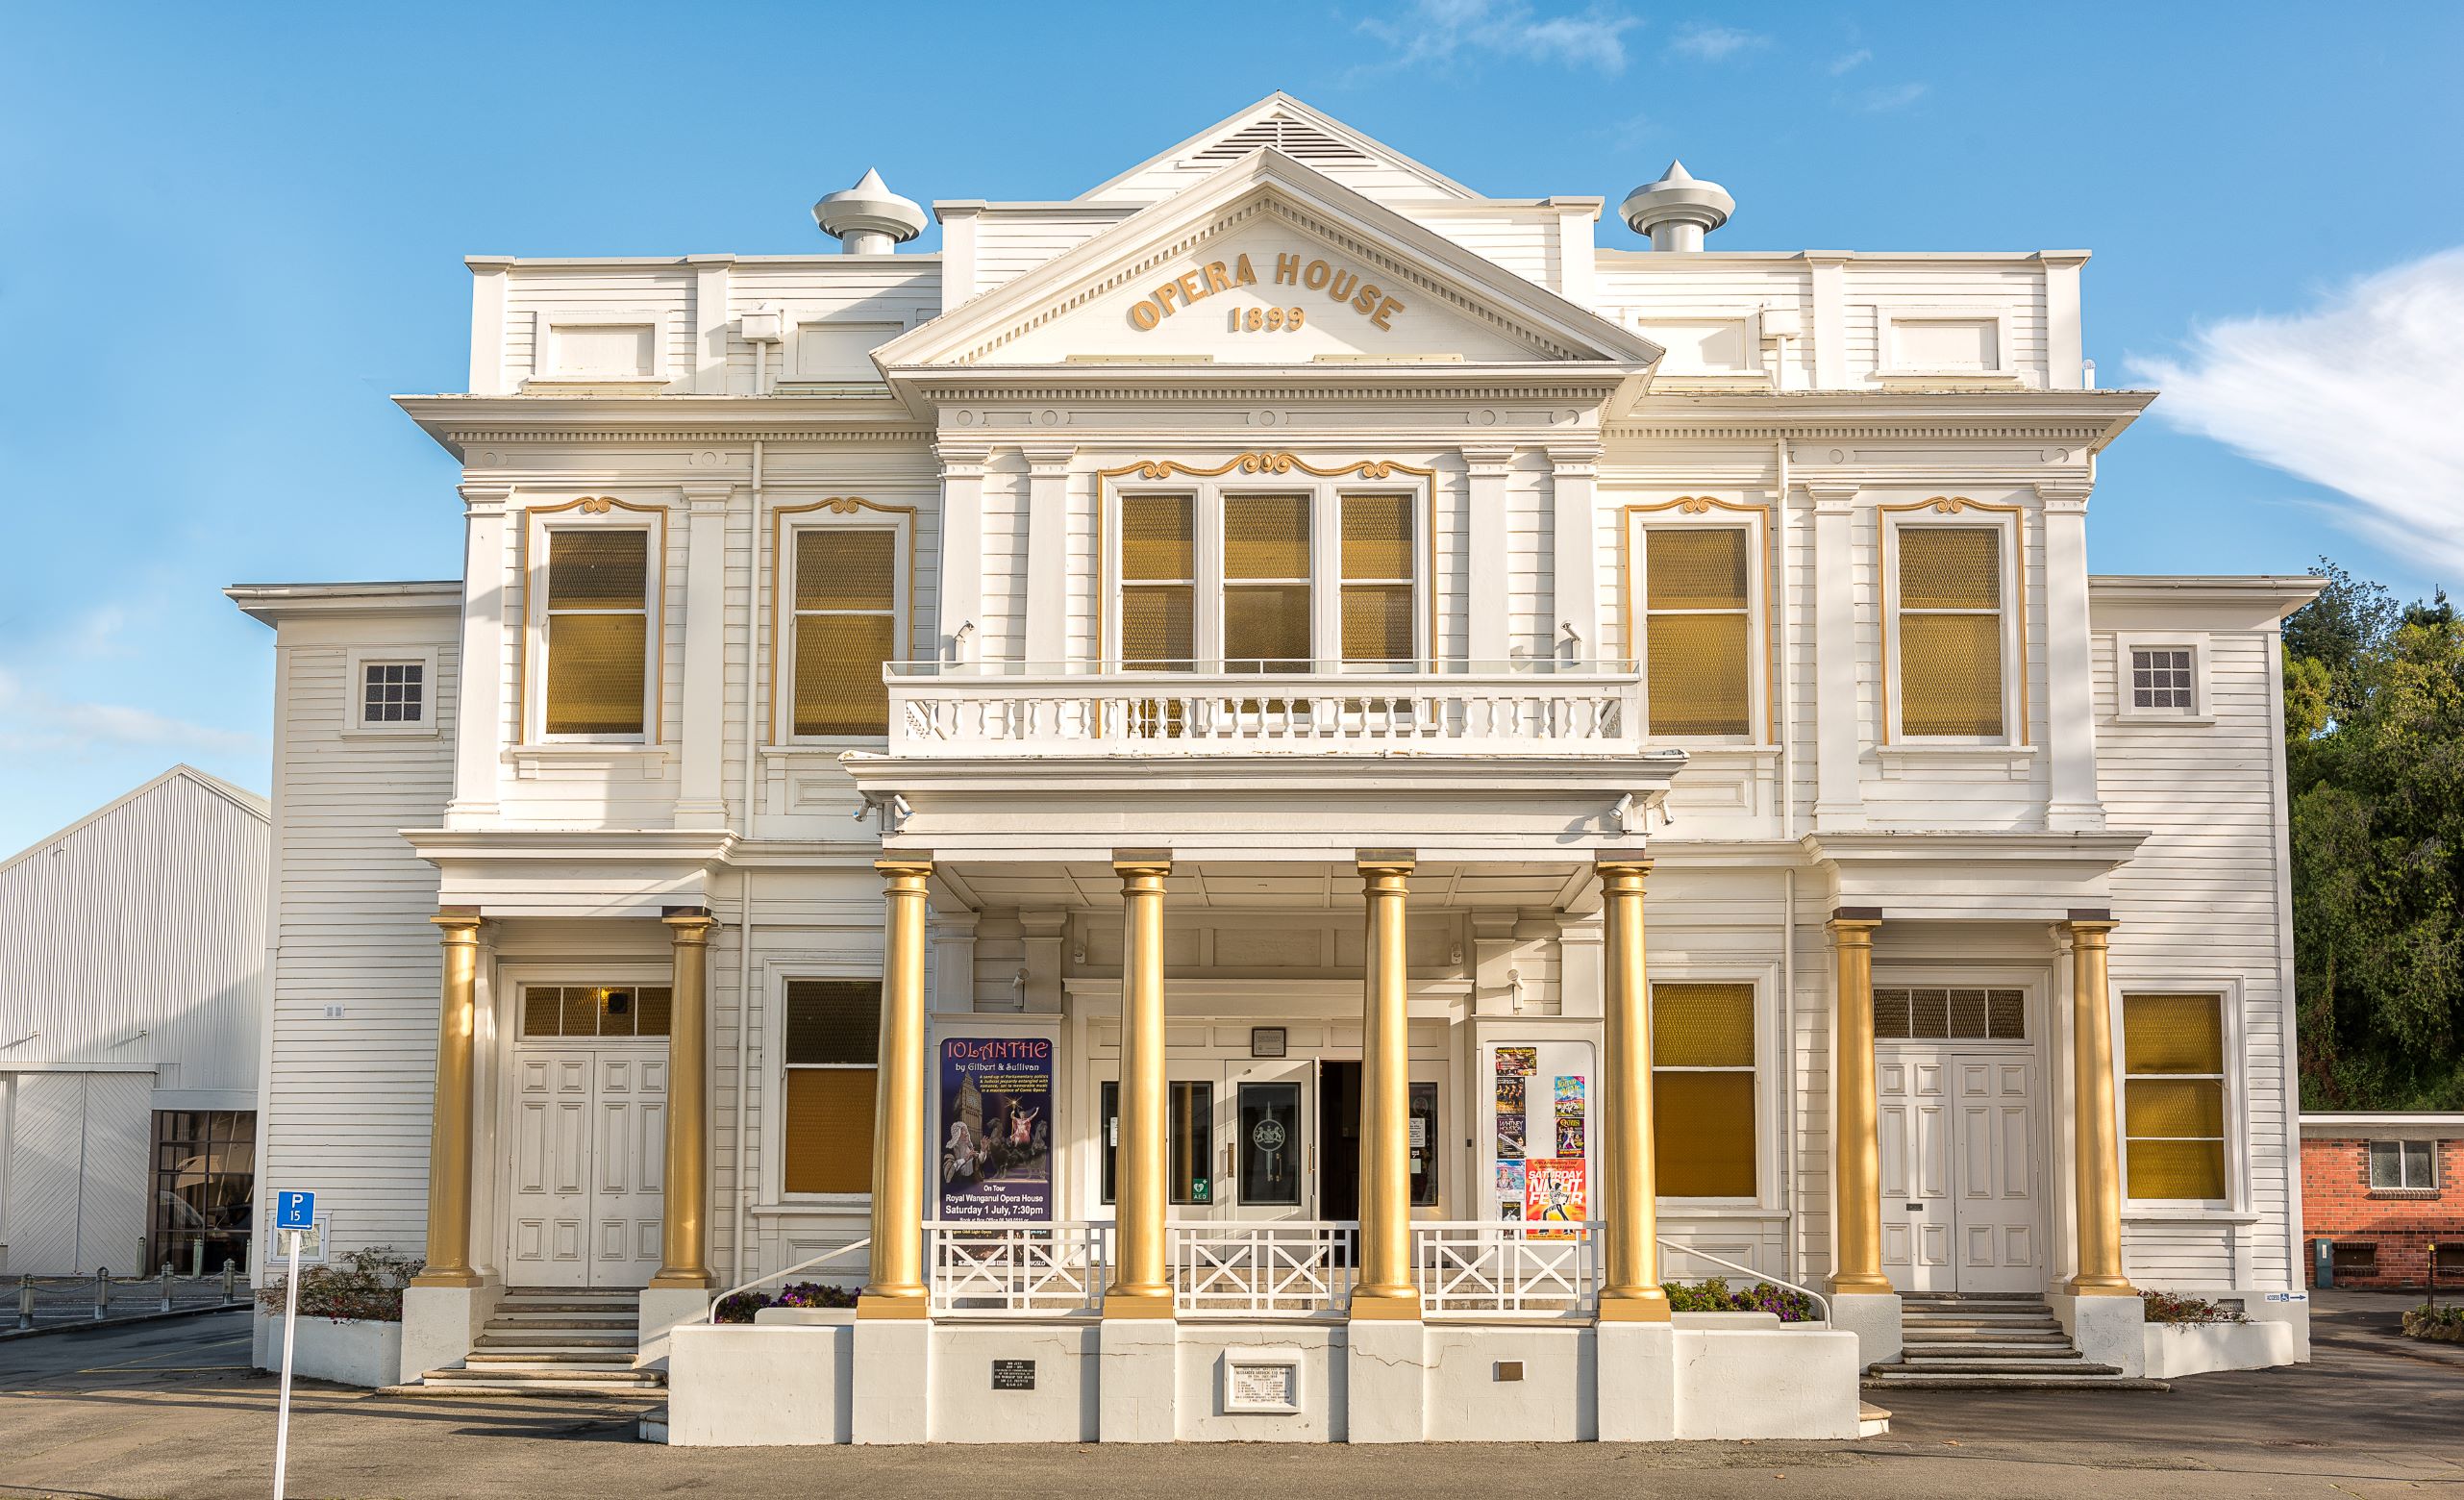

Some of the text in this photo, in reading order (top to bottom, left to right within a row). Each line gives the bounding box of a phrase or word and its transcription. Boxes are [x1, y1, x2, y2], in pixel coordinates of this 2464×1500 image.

[1132, 252, 1406, 332] OPERA HOUSE
[1232, 307, 1306, 332] 1899
[947, 1041, 1049, 1062] IOLANTHE
[955, 1062, 1039, 1072] by Gilbert & Sullivan
[1528, 1171, 1583, 1179] SATURDAY
[292, 1194, 304, 1208] P
[946, 1194, 965, 1203] Royal
[965, 1194, 999, 1203] Wanganui
[1000, 1194, 1020, 1203] Opera
[1529, 1192, 1583, 1205] FER
[290, 1210, 300, 1221] 15
[946, 1205, 983, 1215] Saturday
[991, 1205, 1011, 1215] July,
[1013, 1206, 1044, 1215] 7:30pm
